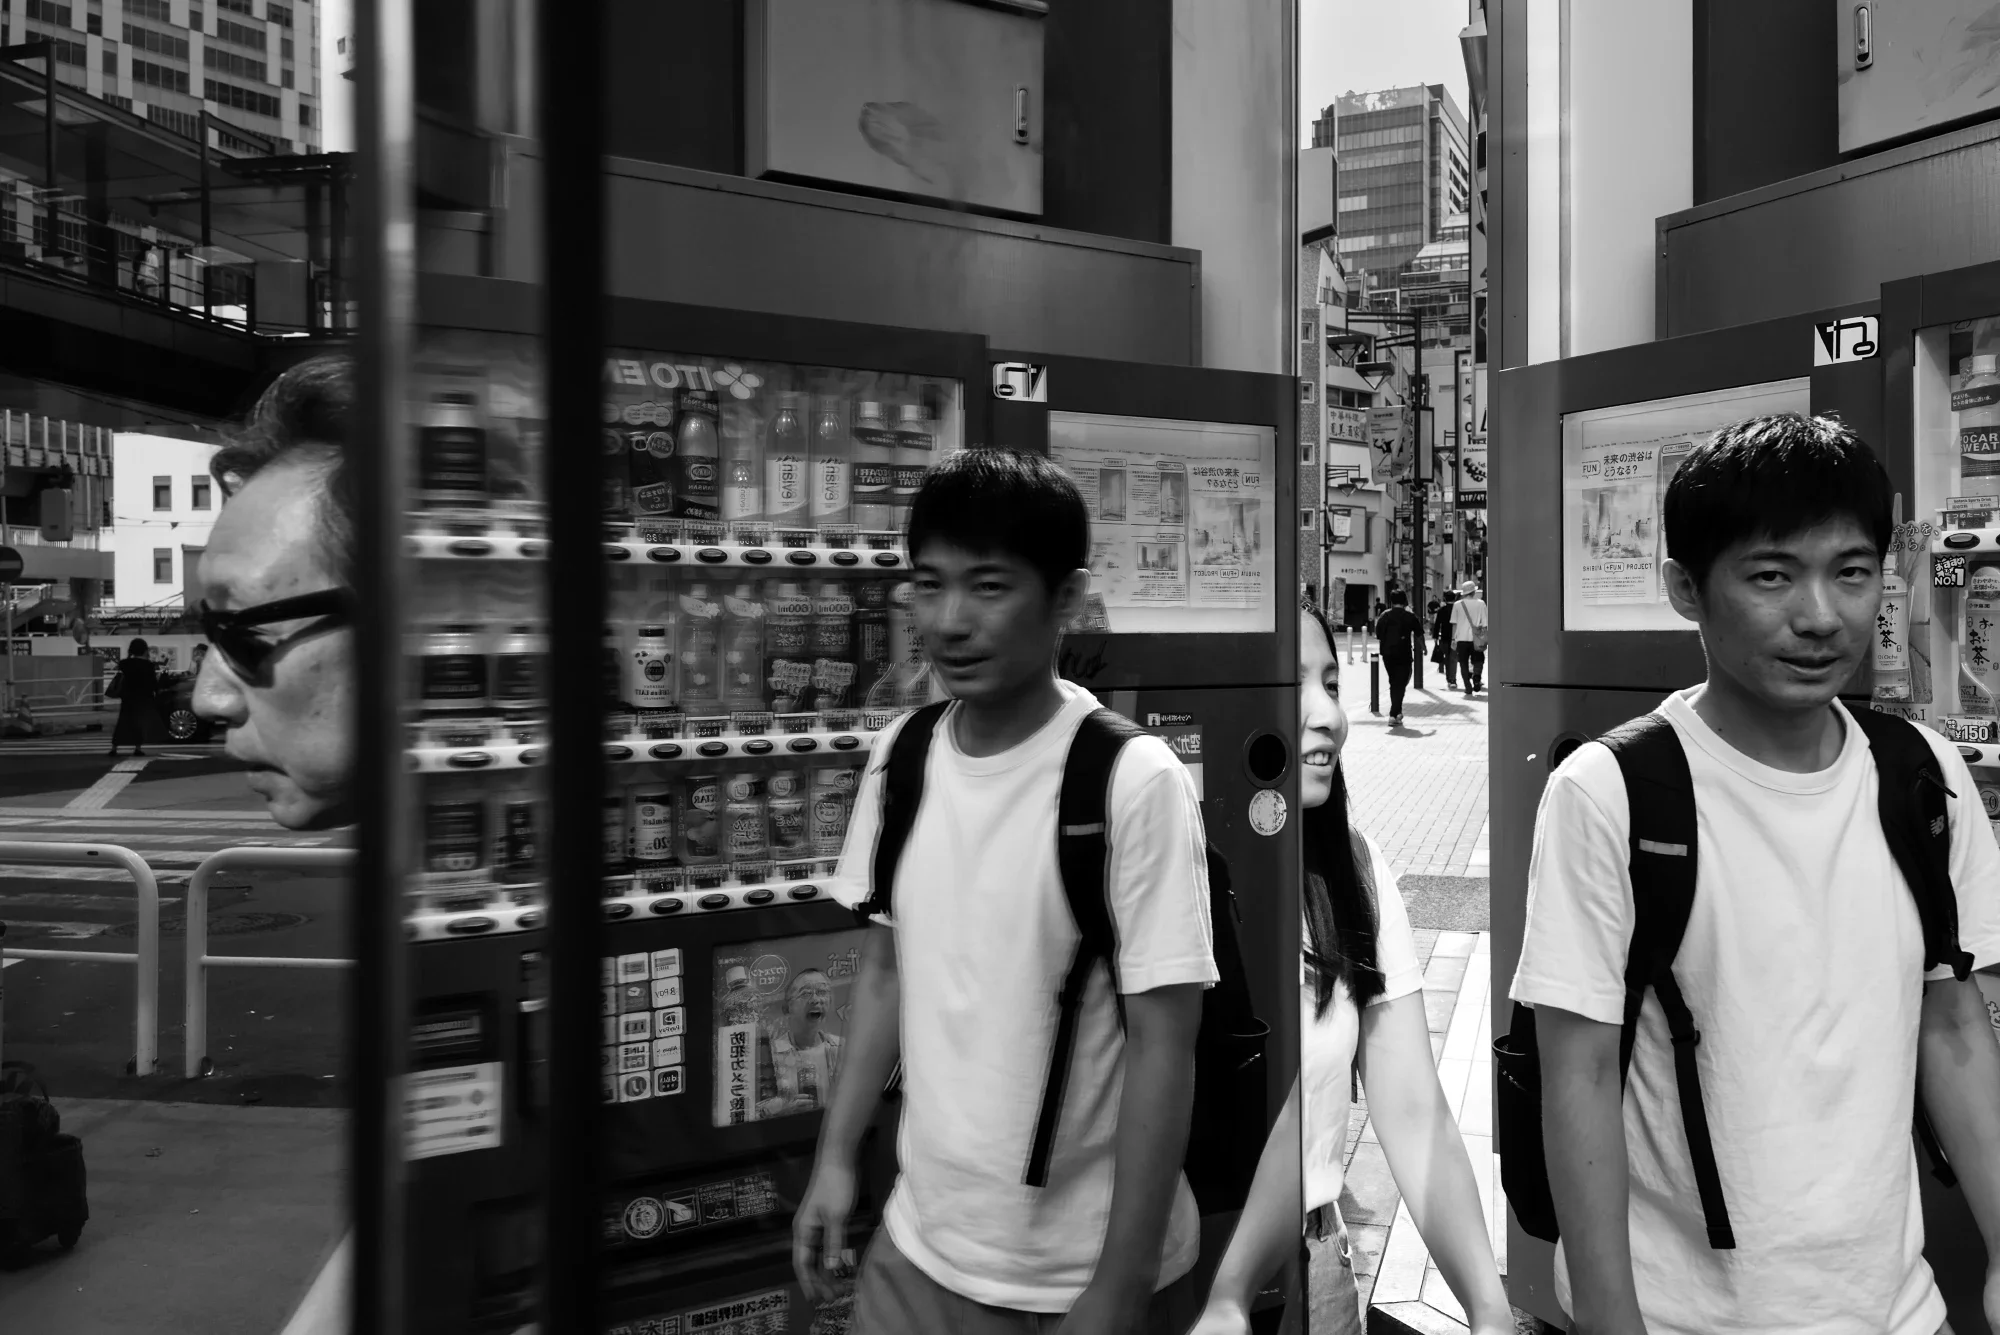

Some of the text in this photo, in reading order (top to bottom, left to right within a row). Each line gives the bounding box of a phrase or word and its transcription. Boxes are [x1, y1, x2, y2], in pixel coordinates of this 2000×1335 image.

[1960, 433, 1999, 444] OCAR
[1960, 442, 2000, 453] WEAT
[1603, 451, 1652, 465] 未来の渋谷は
[1583, 464, 1597, 474] FUN
[1460, 494, 1487, 502] B1F/47
[1893, 523, 1939, 537] やかを、
[1888, 539, 1926, 554] から。
[1626, 563, 1652, 571] PROJECT
[1935, 556, 1965, 571] おすすめ
[1935, 568, 1964, 586] NO.1
[1877, 613, 1897, 649] お茶
[1969, 629, 1990, 666] お茶
[1902, 708, 1927, 721] No.1
[1955, 724, 1990, 741] ¥150
